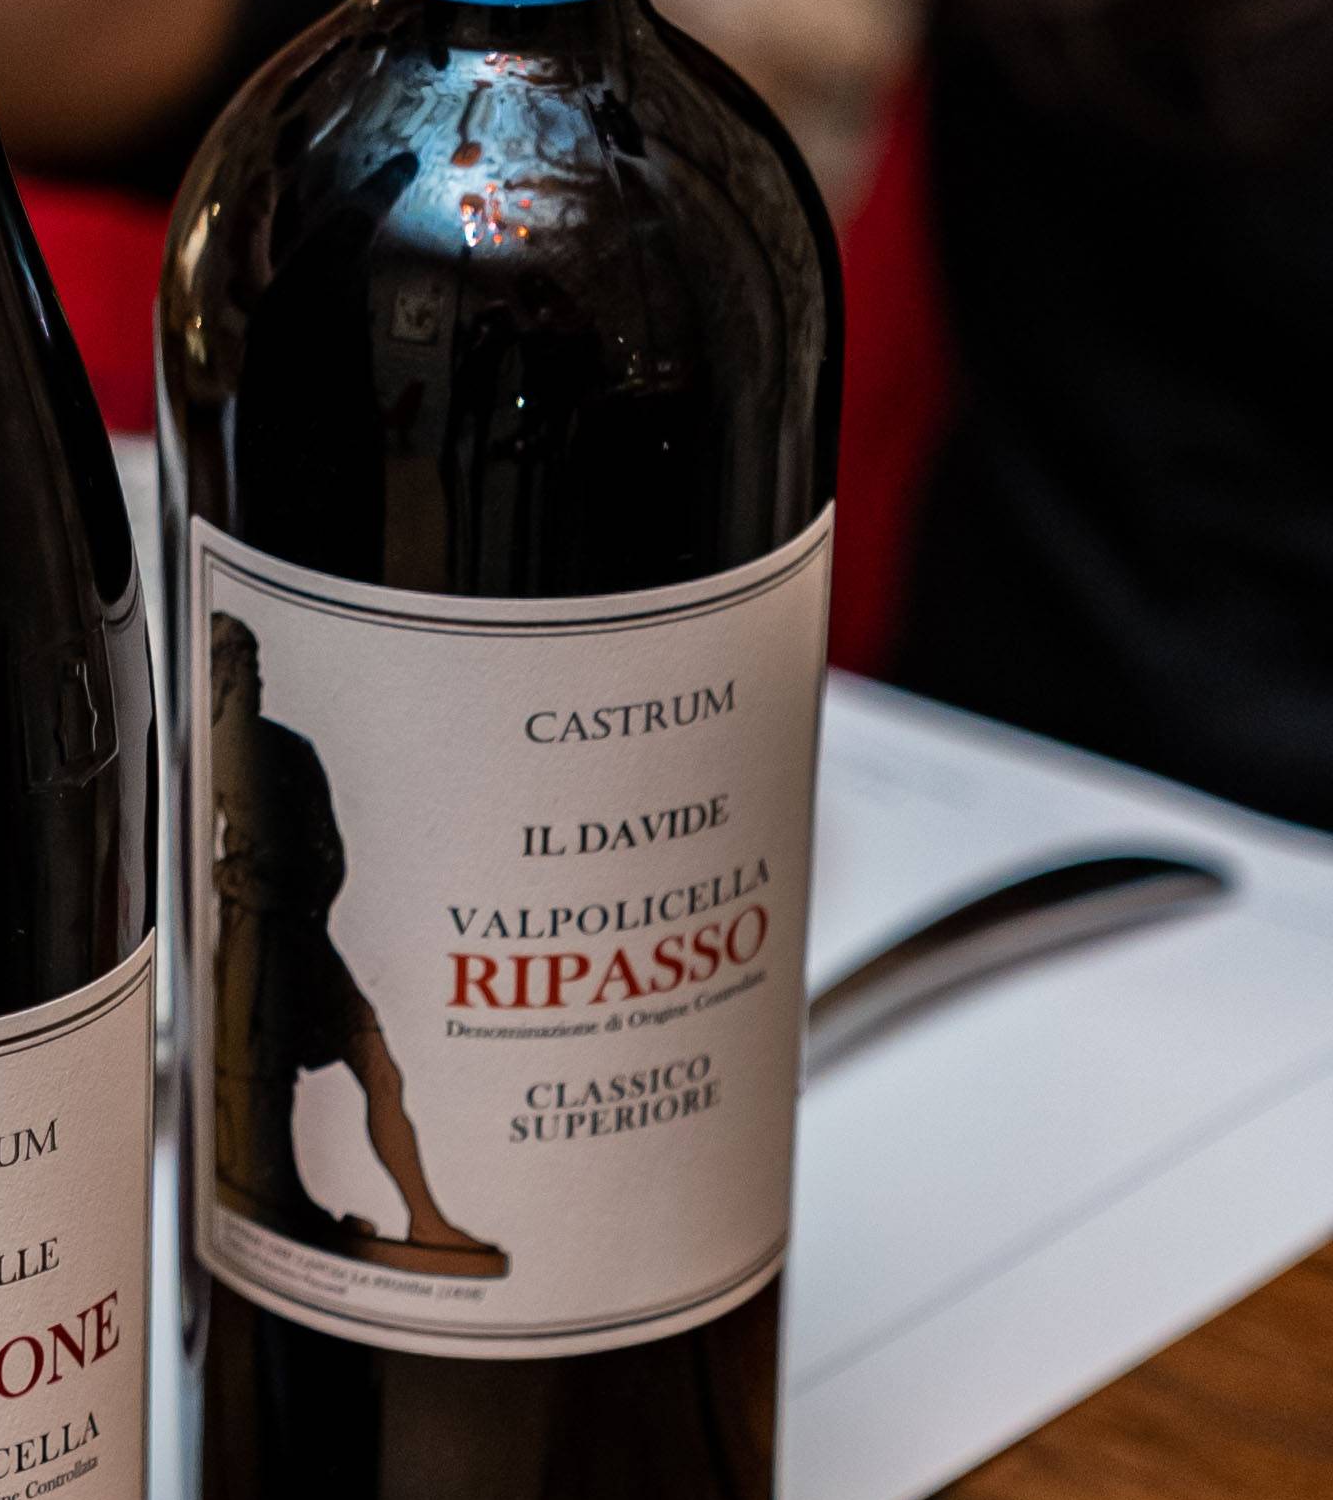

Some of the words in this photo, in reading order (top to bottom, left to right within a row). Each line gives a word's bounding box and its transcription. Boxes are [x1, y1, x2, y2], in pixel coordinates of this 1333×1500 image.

[524, 679, 736, 744] CASTRUM
[522, 825, 566, 857] IL
[577, 793, 729, 855] DAVIDE
[447, 857, 770, 939] VALPOLICELLA
[446, 903, 769, 1009] RIPASSO
[445, 1018, 600, 1039] Denominazione
[604, 1012, 623, 1032] di
[509, 1079, 722, 1144] SUPERIORE
[526, 1053, 712, 1110] CLASSICO
[25, 1454, 99, 1499] Controllata
